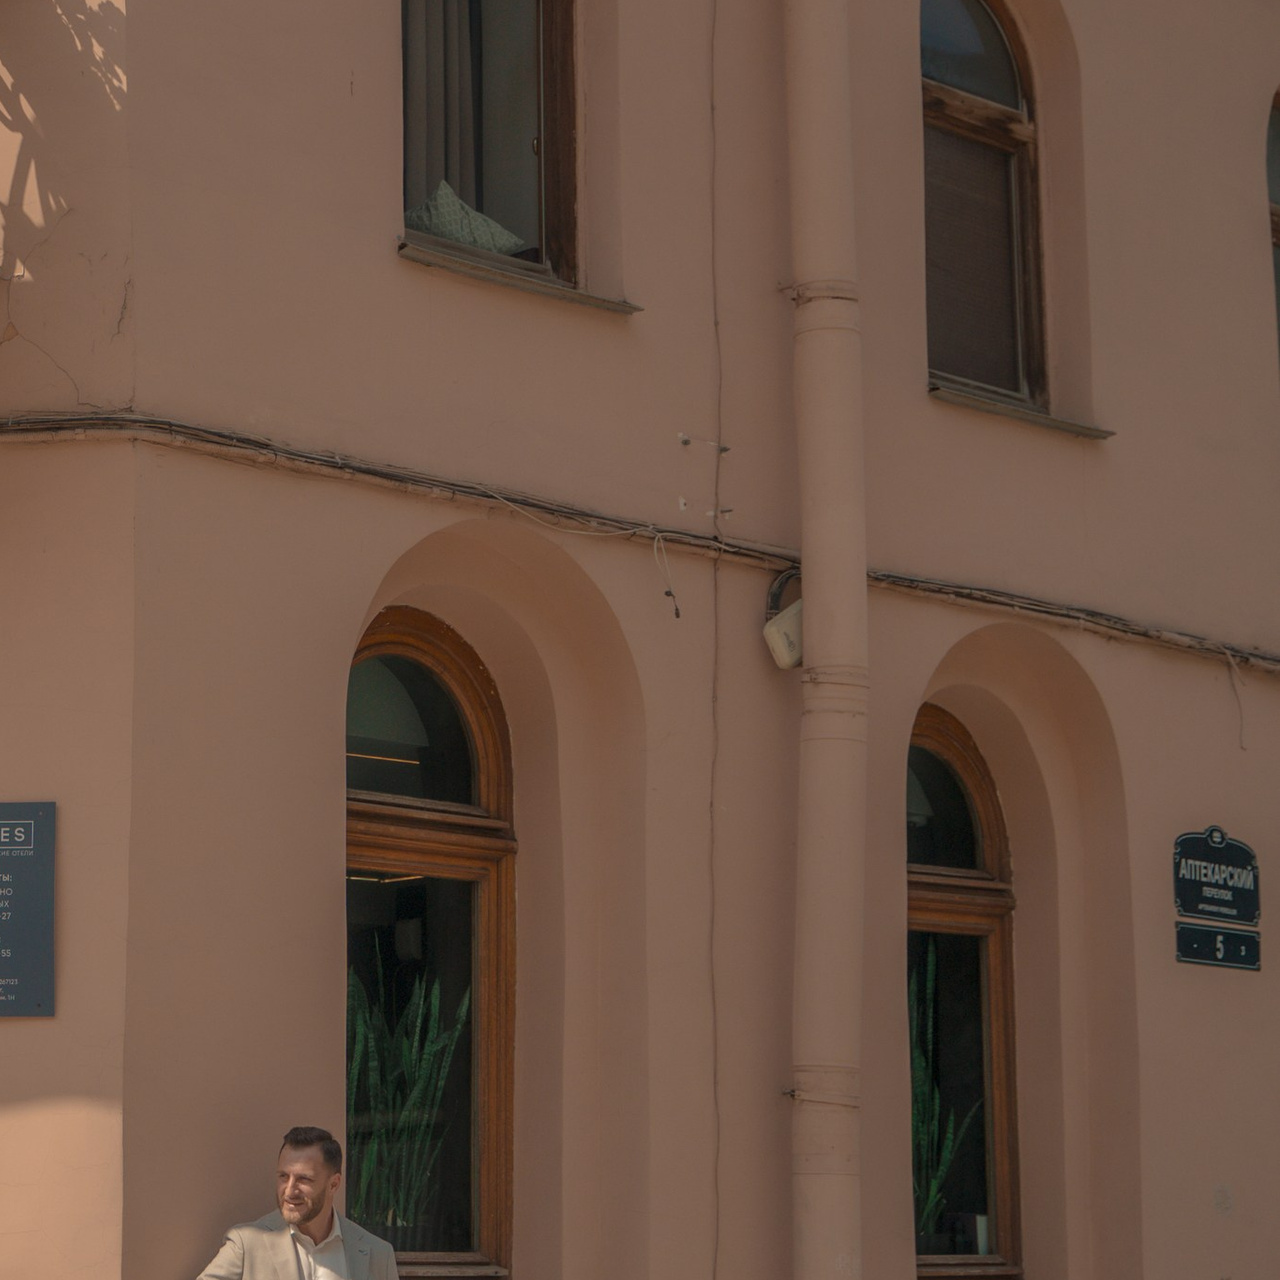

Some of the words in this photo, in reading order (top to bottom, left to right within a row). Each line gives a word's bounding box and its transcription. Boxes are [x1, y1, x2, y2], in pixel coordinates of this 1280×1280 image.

[12, 849, 34, 857] ОТЕЛИ
[1179, 858, 1254, 890] АПТЕКАРСКИЙ
[1215, 935, 1224, 959] 5
